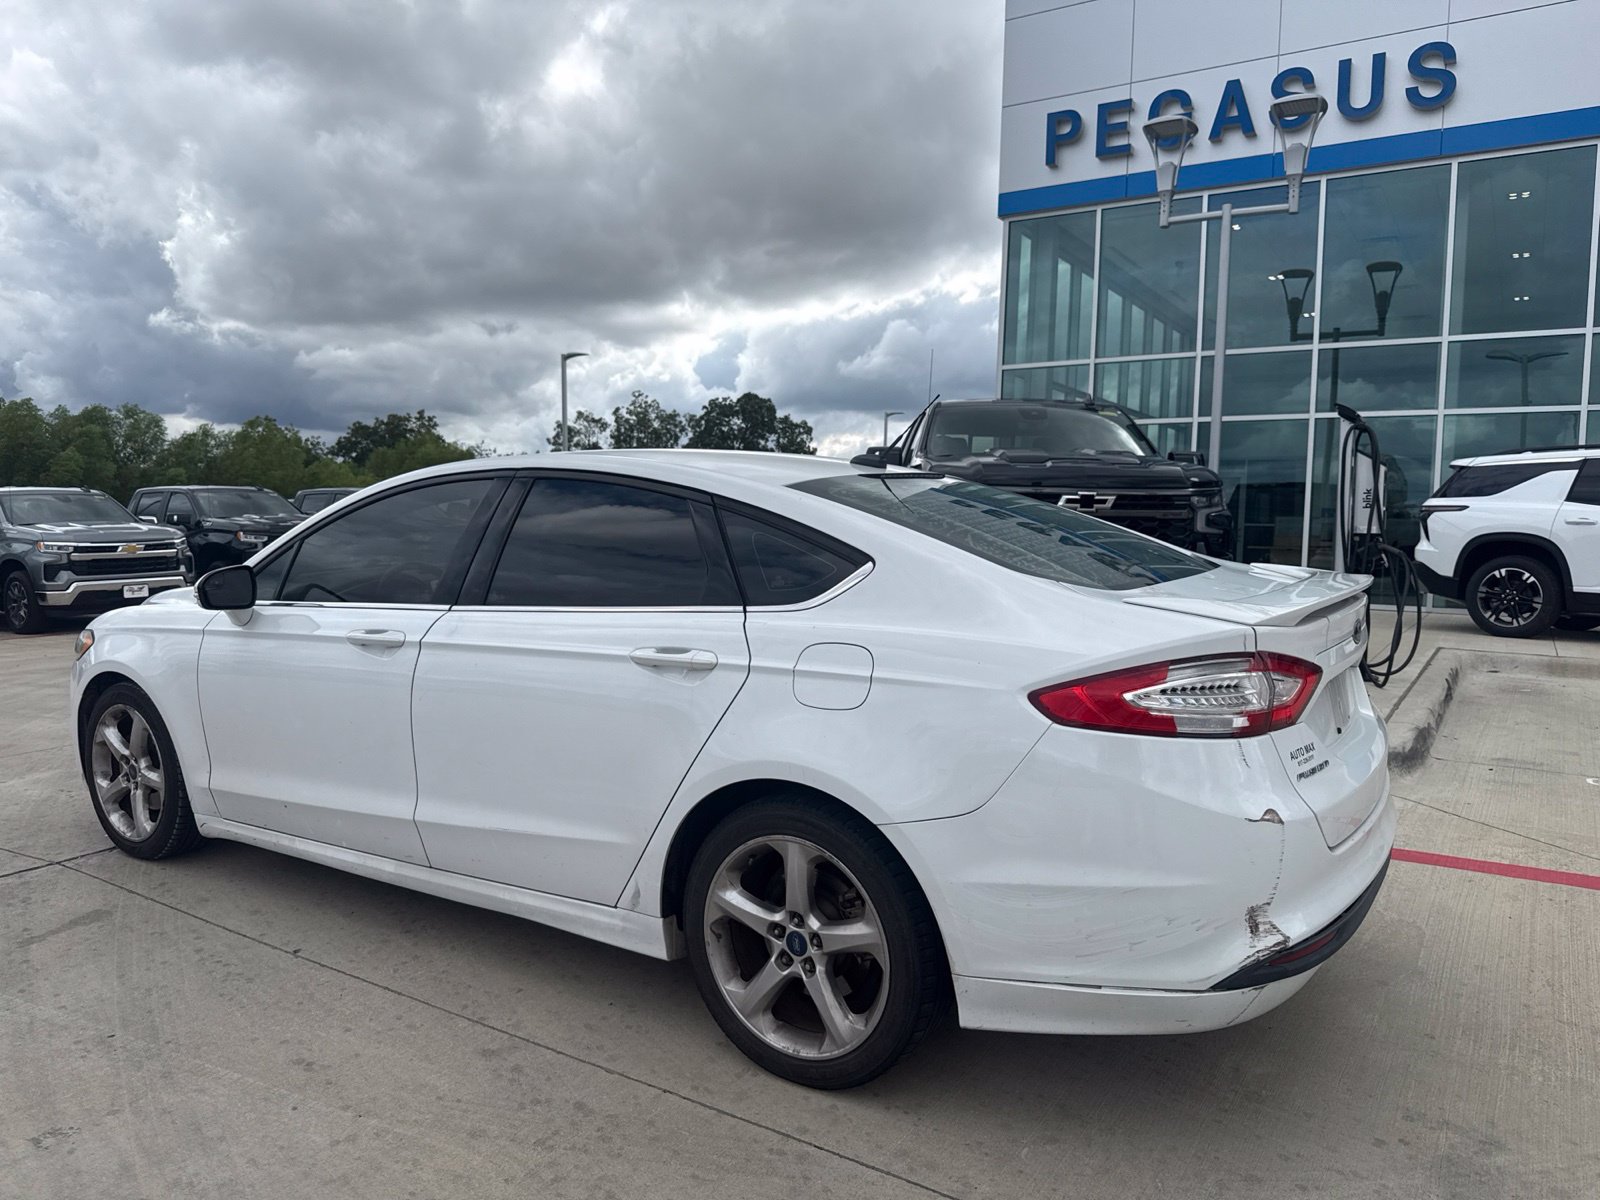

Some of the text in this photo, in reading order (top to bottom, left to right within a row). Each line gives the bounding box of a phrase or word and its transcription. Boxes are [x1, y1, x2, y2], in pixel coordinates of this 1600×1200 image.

[1045, 41, 1457, 168] PEGASUS
[1362, 489, 1372, 509] blink
[1290, 742, 1315, 760] AUTO MAX
